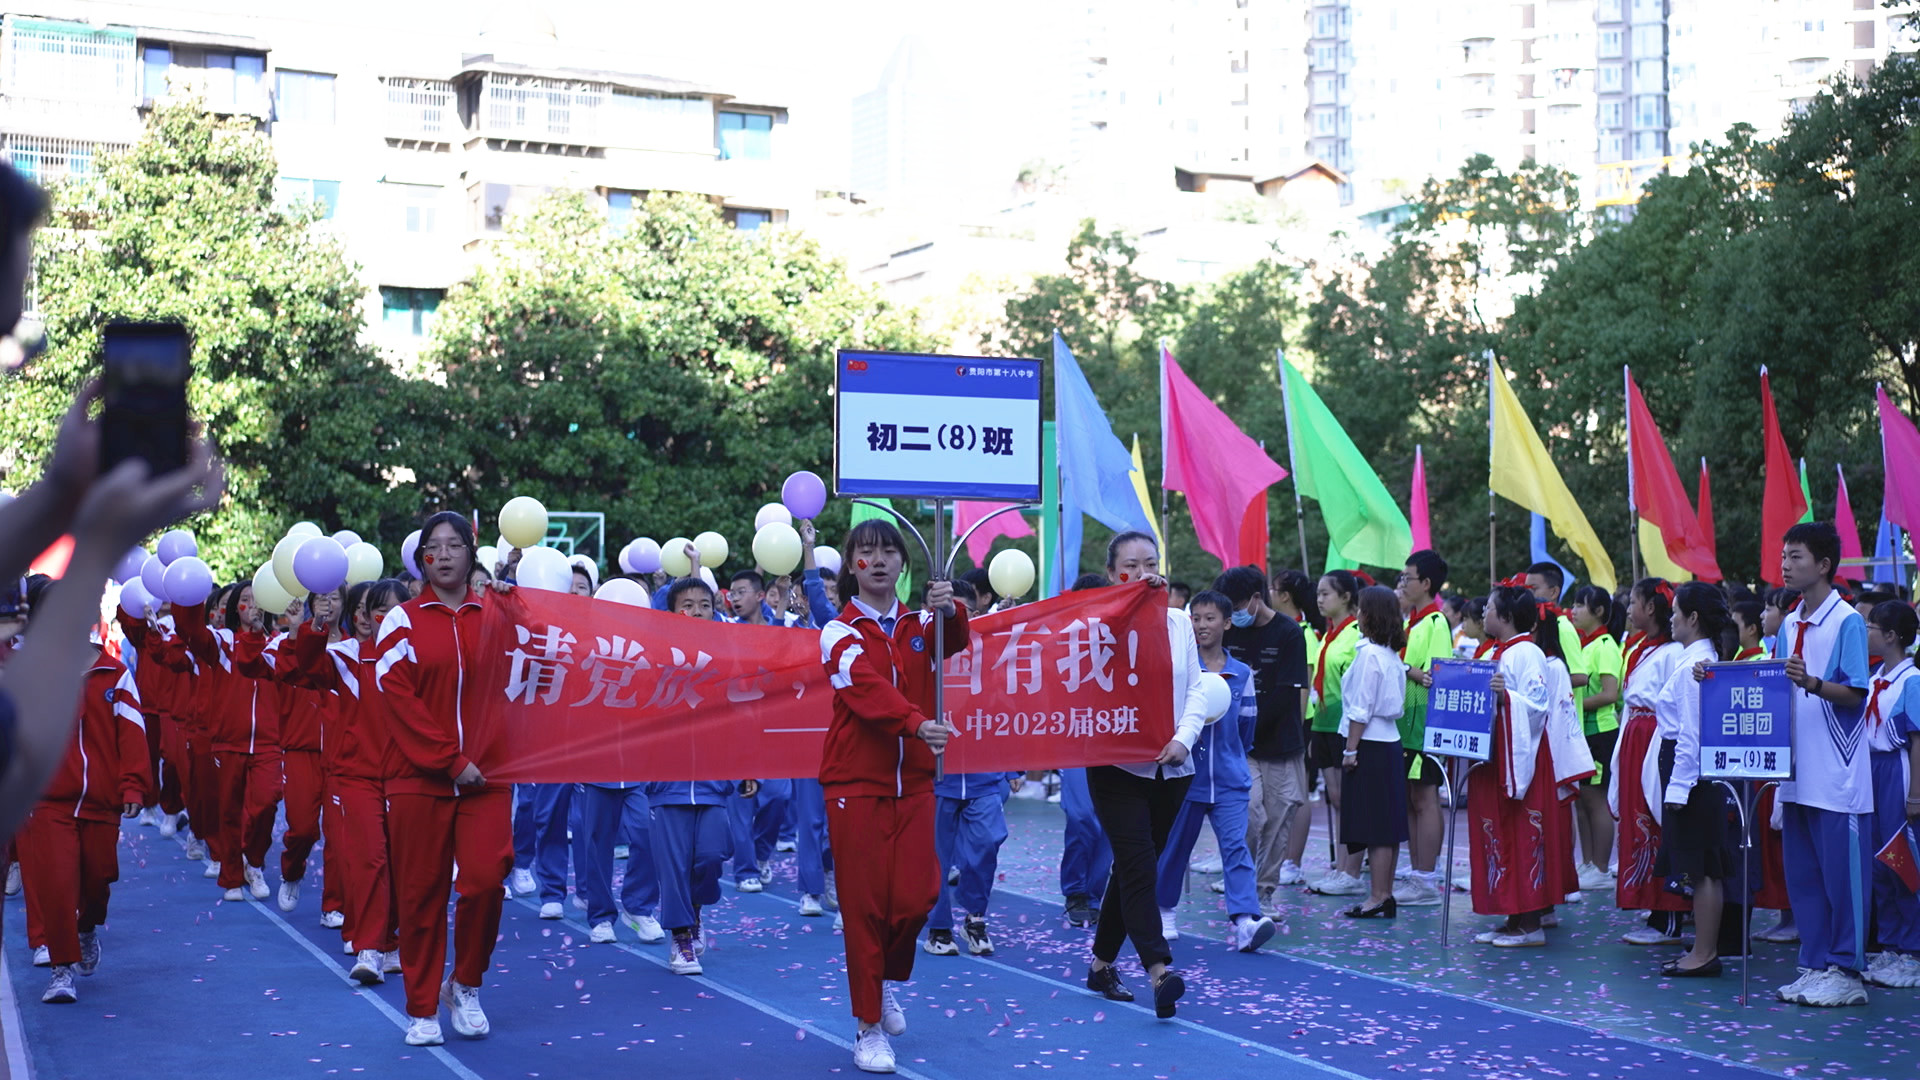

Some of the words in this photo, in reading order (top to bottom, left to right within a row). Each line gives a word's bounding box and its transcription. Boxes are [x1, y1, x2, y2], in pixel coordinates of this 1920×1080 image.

[969, 367, 1034, 378] 贵阳市第十八中学
[866, 422, 1014, 456] 初二（8）班
[1434, 687, 1486, 715] 涵碧诗社
[1730, 686, 1764, 709] 风笛
[1722, 712, 1773, 736] 合唱团
[1433, 731, 1480, 753] 初一（8）班
[1714, 750, 1777, 771] 初一（9）班
